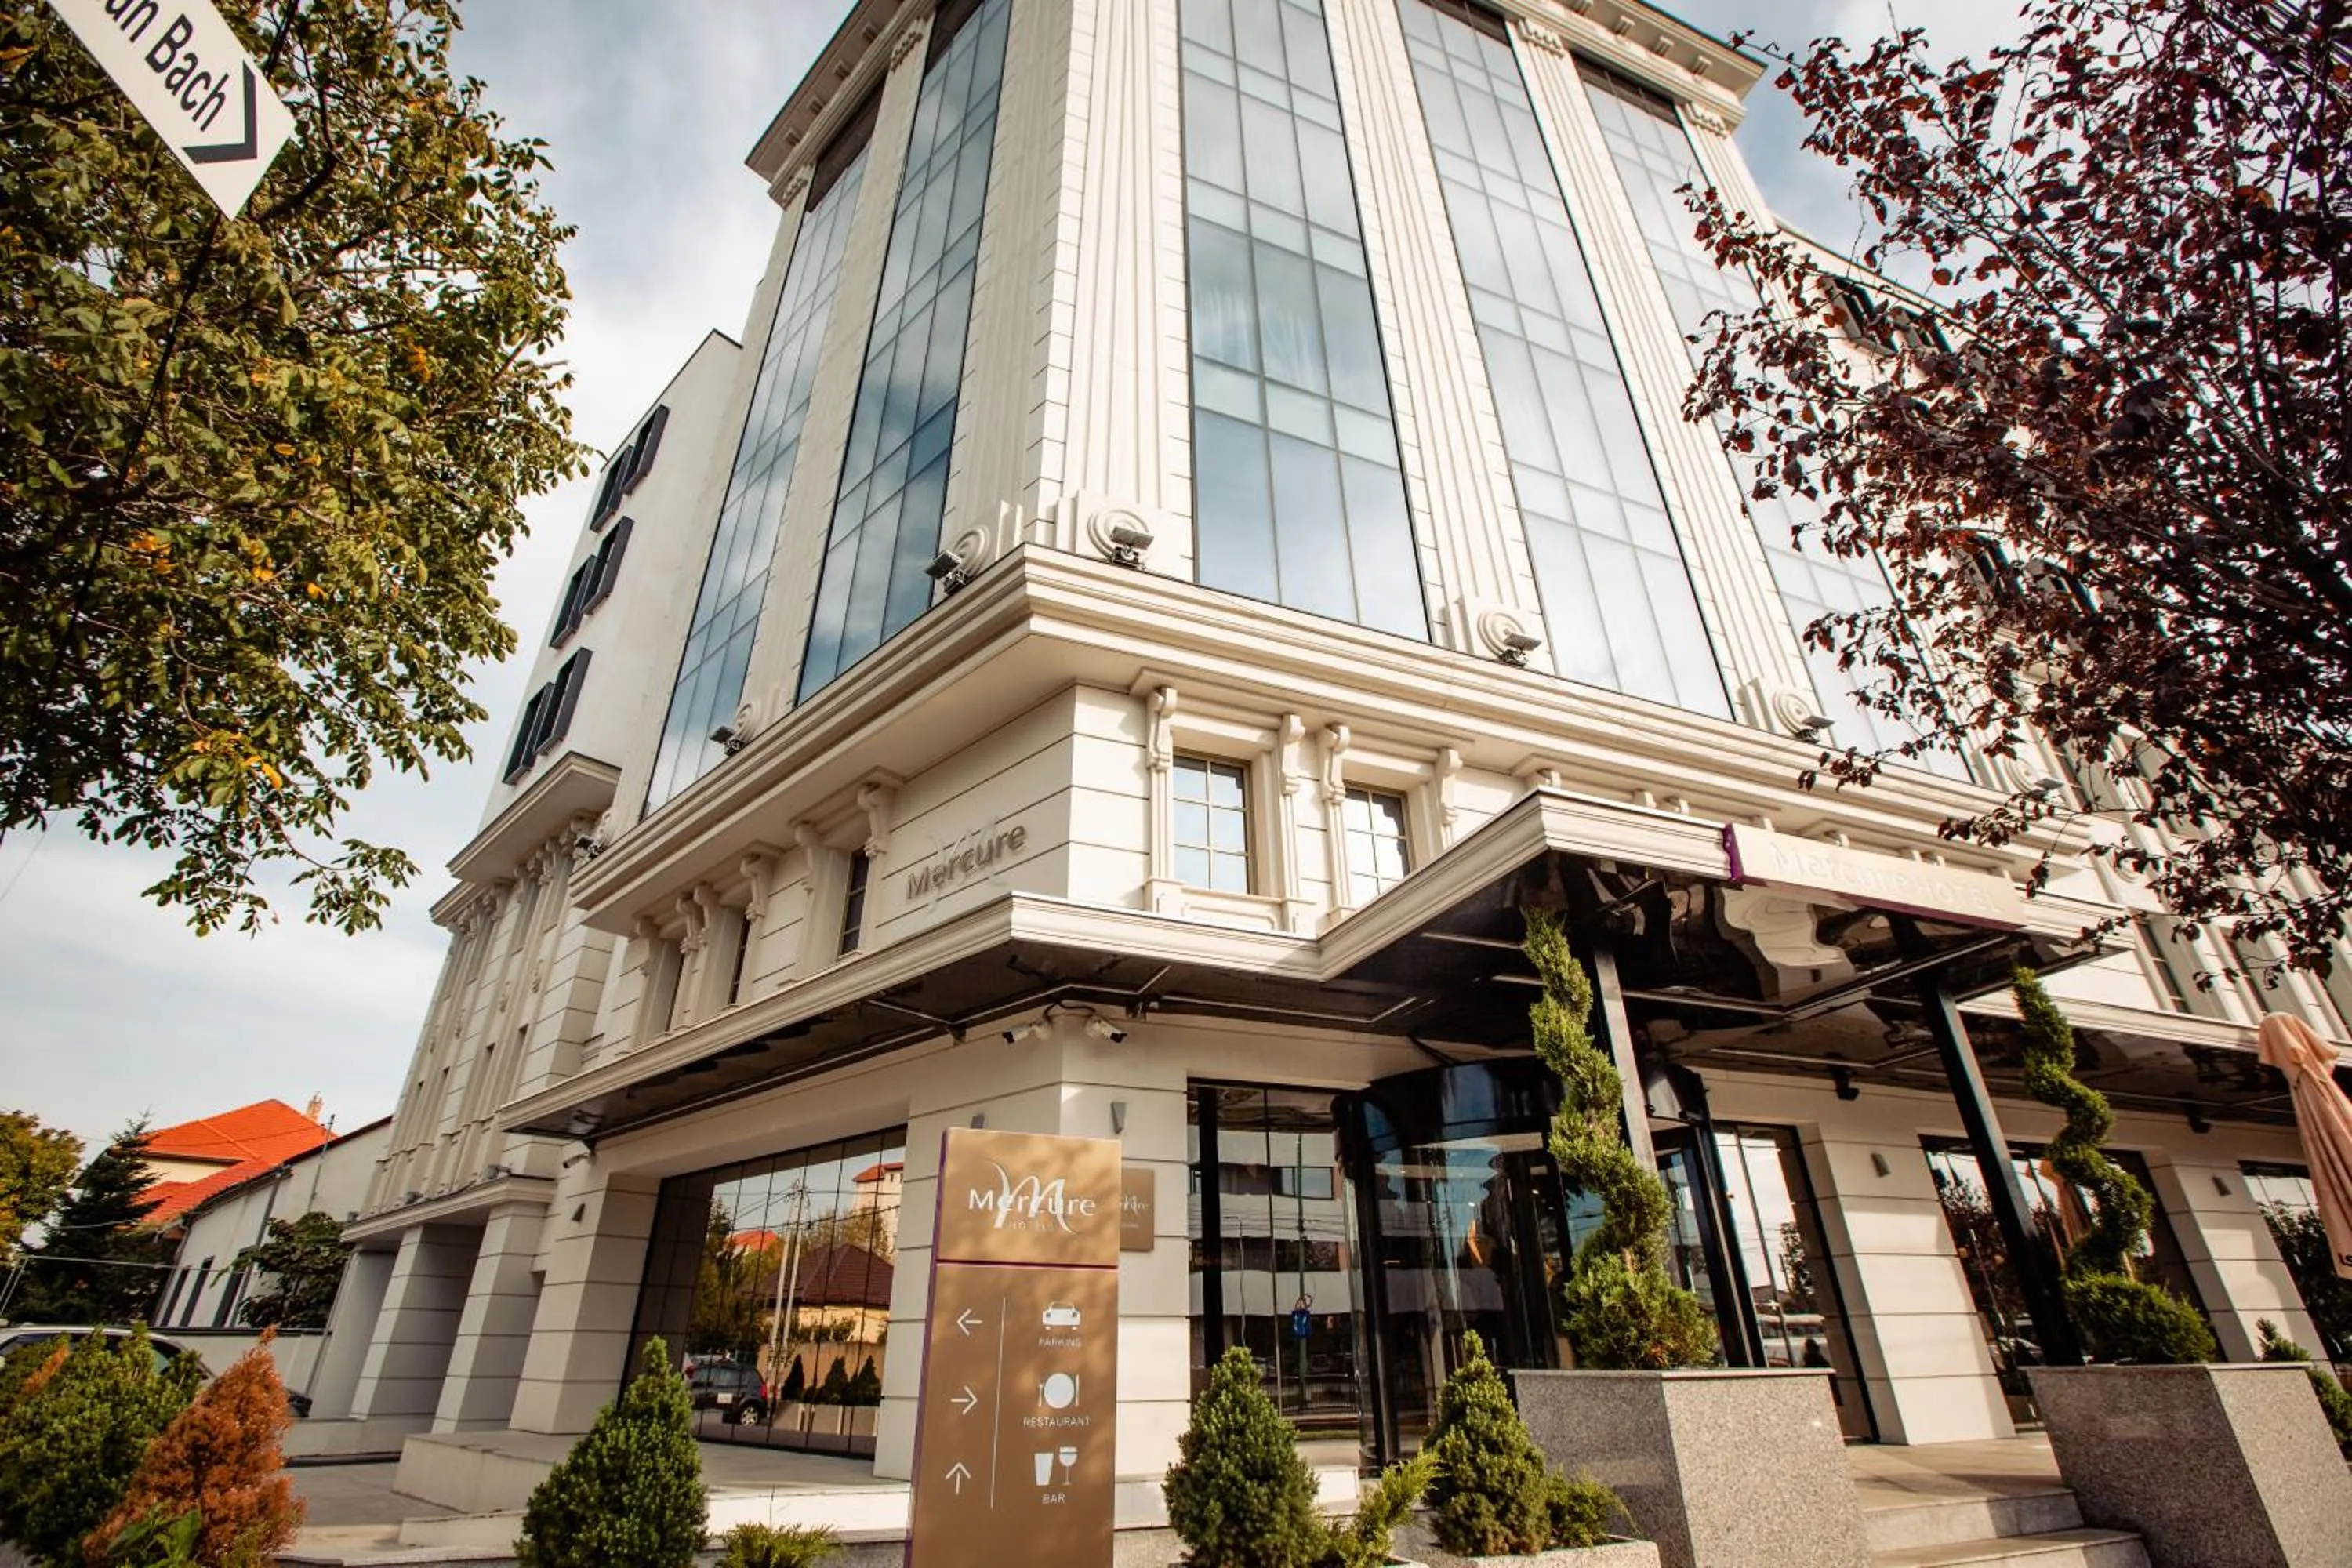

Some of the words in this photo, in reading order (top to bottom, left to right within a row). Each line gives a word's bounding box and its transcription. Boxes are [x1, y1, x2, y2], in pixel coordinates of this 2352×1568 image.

[144, 13, 230, 132] Bach
[906, 825, 1025, 900] Mercure
[1038, 1337, 1083, 1348] PARKING
[1023, 1416, 1091, 1428] RESTAURANT
[1041, 1493, 1066, 1504] BAR
